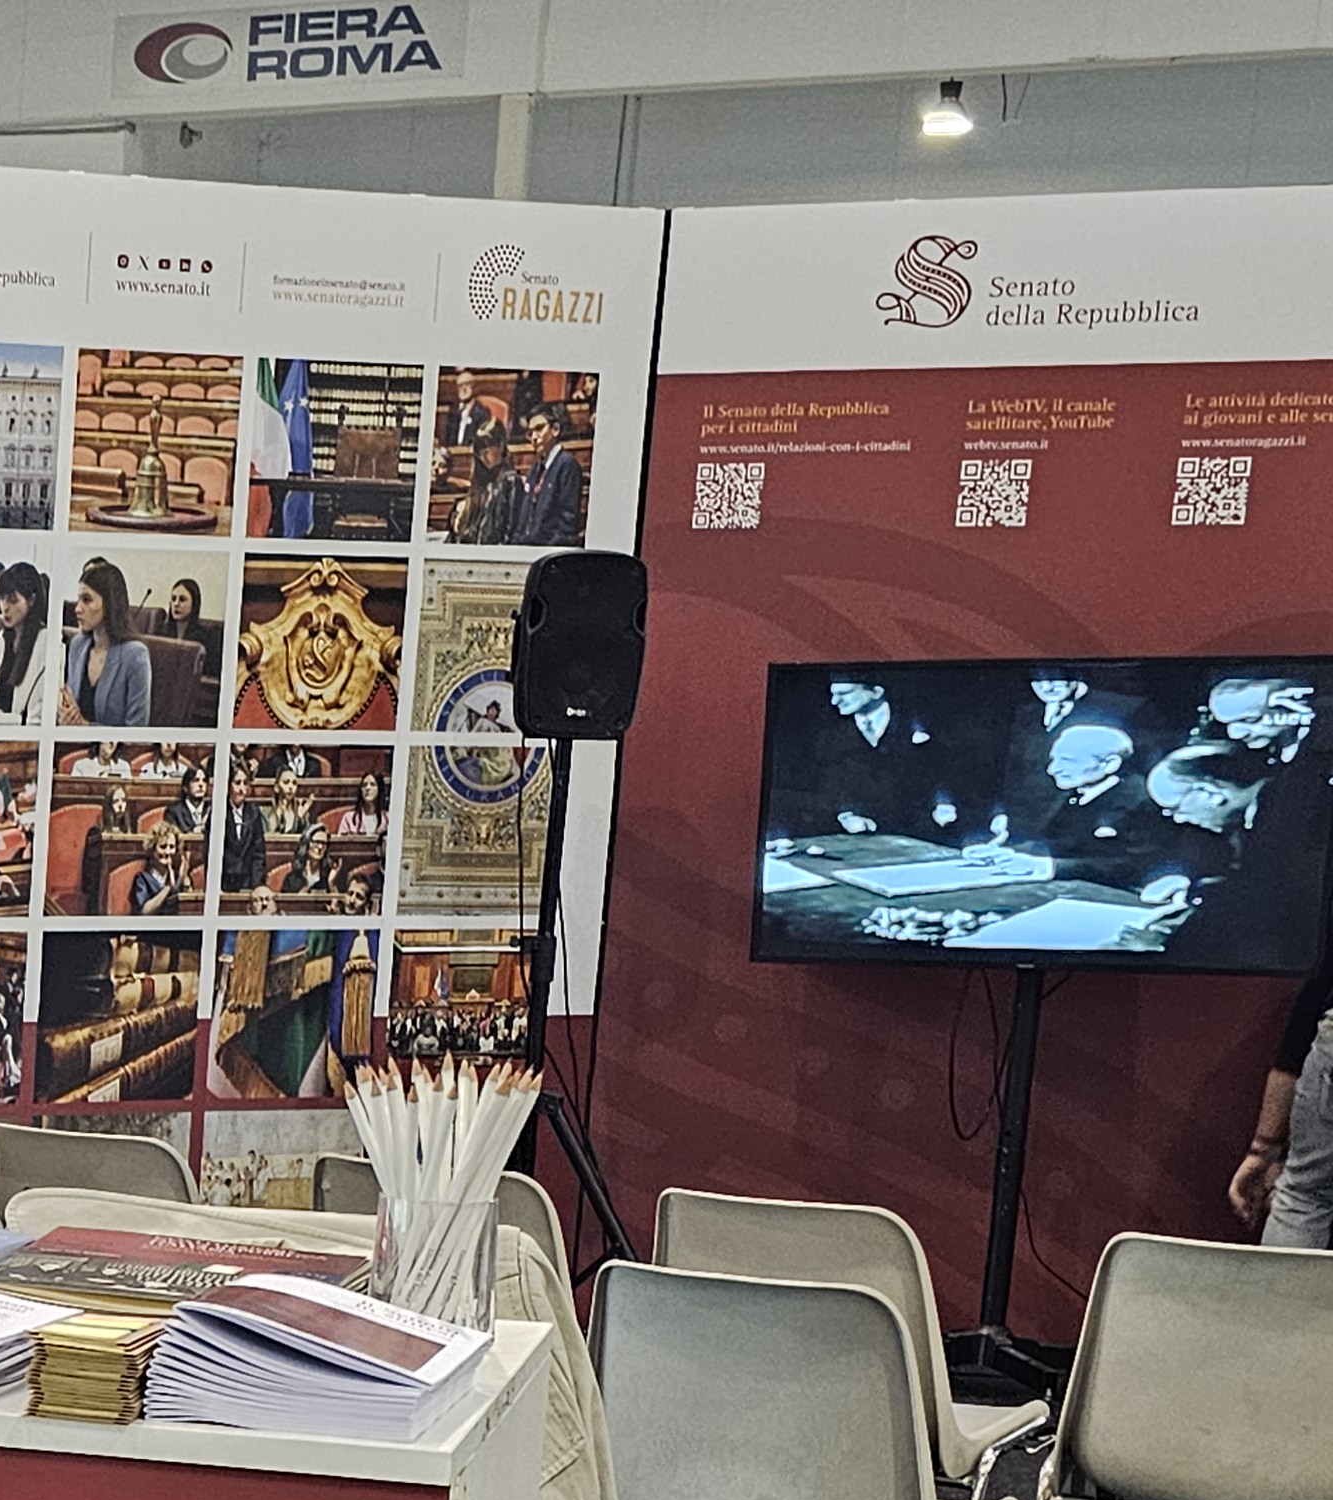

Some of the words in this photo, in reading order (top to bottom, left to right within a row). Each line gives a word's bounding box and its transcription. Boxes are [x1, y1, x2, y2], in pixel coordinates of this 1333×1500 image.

[249, 4, 425, 46] FIERA
[247, 39, 442, 82] ROMA
[116, 278, 211, 297] www.senato.it
[521, 271, 560, 286] Senato
[989, 276, 1076, 299] Senato
[501, 287, 605, 325] RAGAZZI
[985, 303, 1046, 327] della
[1056, 300, 1200, 330] Repubblica
[967, 399, 986, 414] La
[1053, 398, 1064, 413] il
[1066, 397, 1116, 413] canale
[1186, 392, 1205, 408] Le
[1208, 391, 1266, 408] attività
[703, 404, 714, 419] Il
[717, 403, 767, 418] Senato
[770, 402, 805, 417] della
[808, 401, 891, 419] Repubblica
[1183, 410, 1200, 425] ai
[1202, 409, 1263, 429] giovani
[1266, 413, 1277, 424] e
[1279, 408, 1308, 423] alle
[701, 422, 726, 437] per
[737, 419, 798, 434] cittadini
[1049, 414, 1115, 431] YouTube
[964, 438, 1049, 451] webtv.senato.it
[1181, 434, 1306, 449] www.senatoragazzi.it
